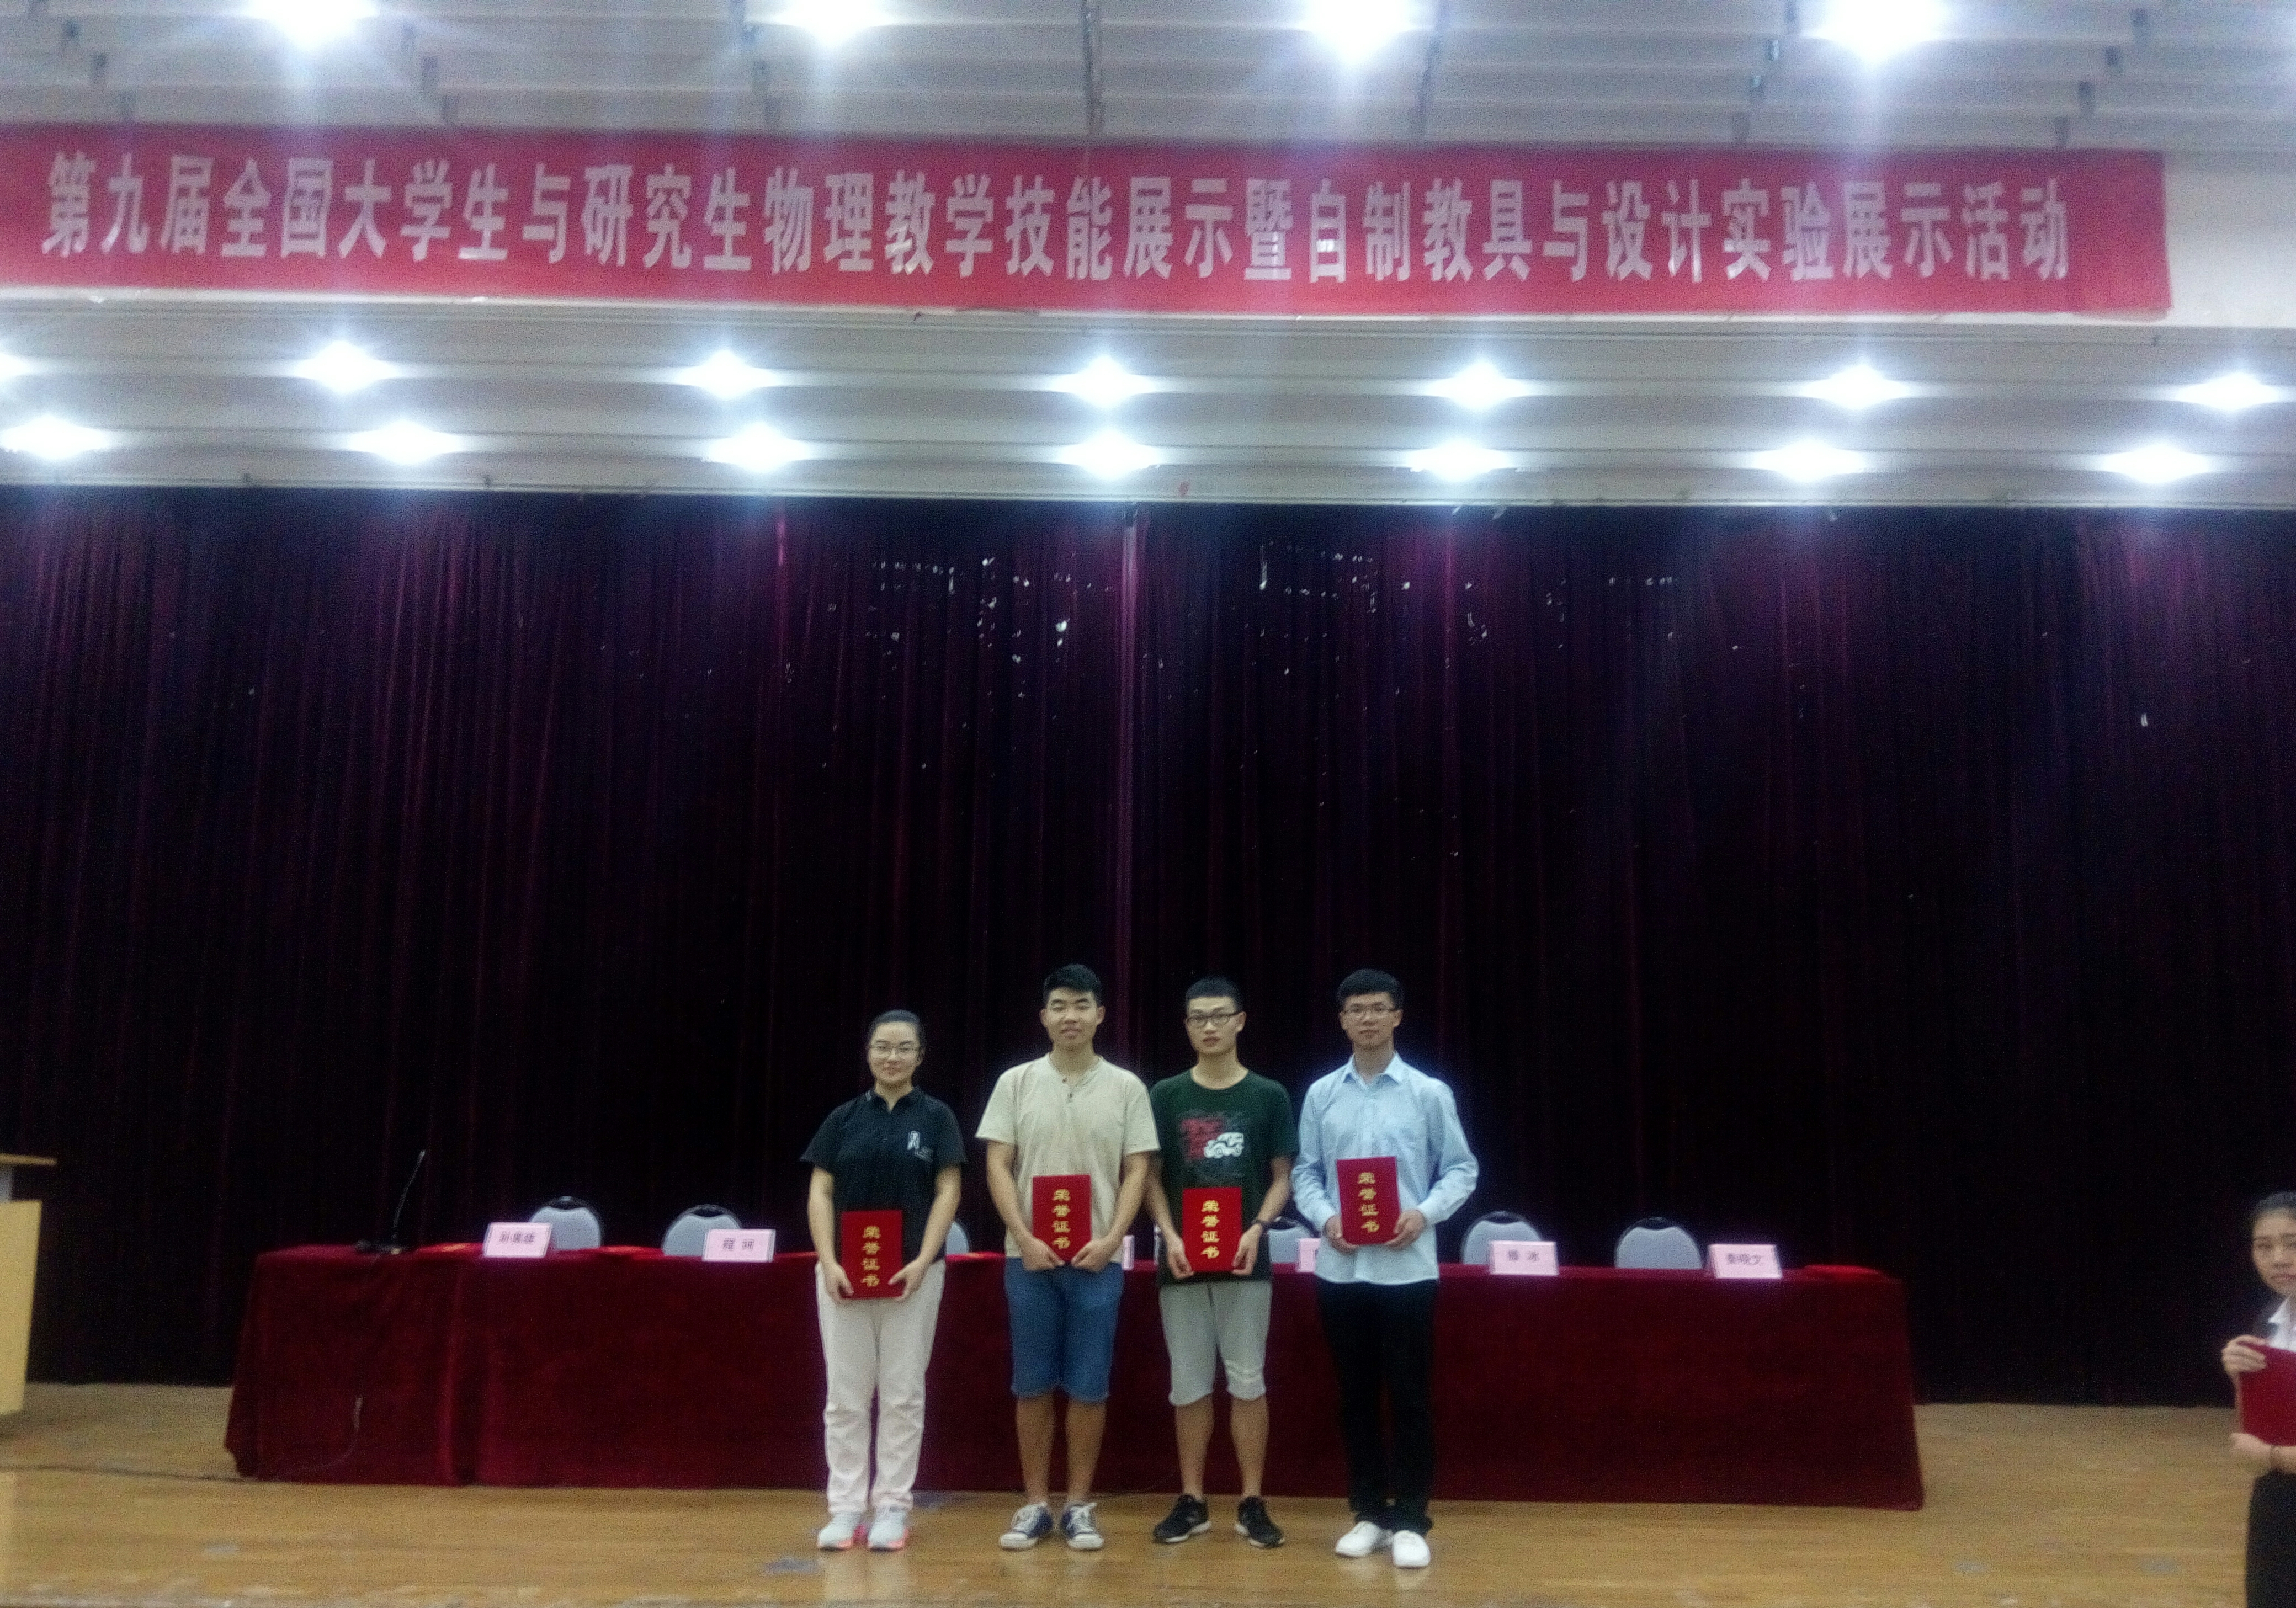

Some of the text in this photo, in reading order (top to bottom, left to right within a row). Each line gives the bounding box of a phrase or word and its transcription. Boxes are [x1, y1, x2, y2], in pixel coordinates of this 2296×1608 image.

[41, 150, 2070, 283] 第九届全国大学生与研究生物理教学技能展示暨自制教具与设计实验展示活动
[1052, 1188, 1071, 1249] 荣誉证书
[1200, 1199, 1220, 1260] 荣誉证书
[1357, 1172, 1379, 1233] 荣誉证书
[861, 1226, 881, 1287] 荣誉证书
